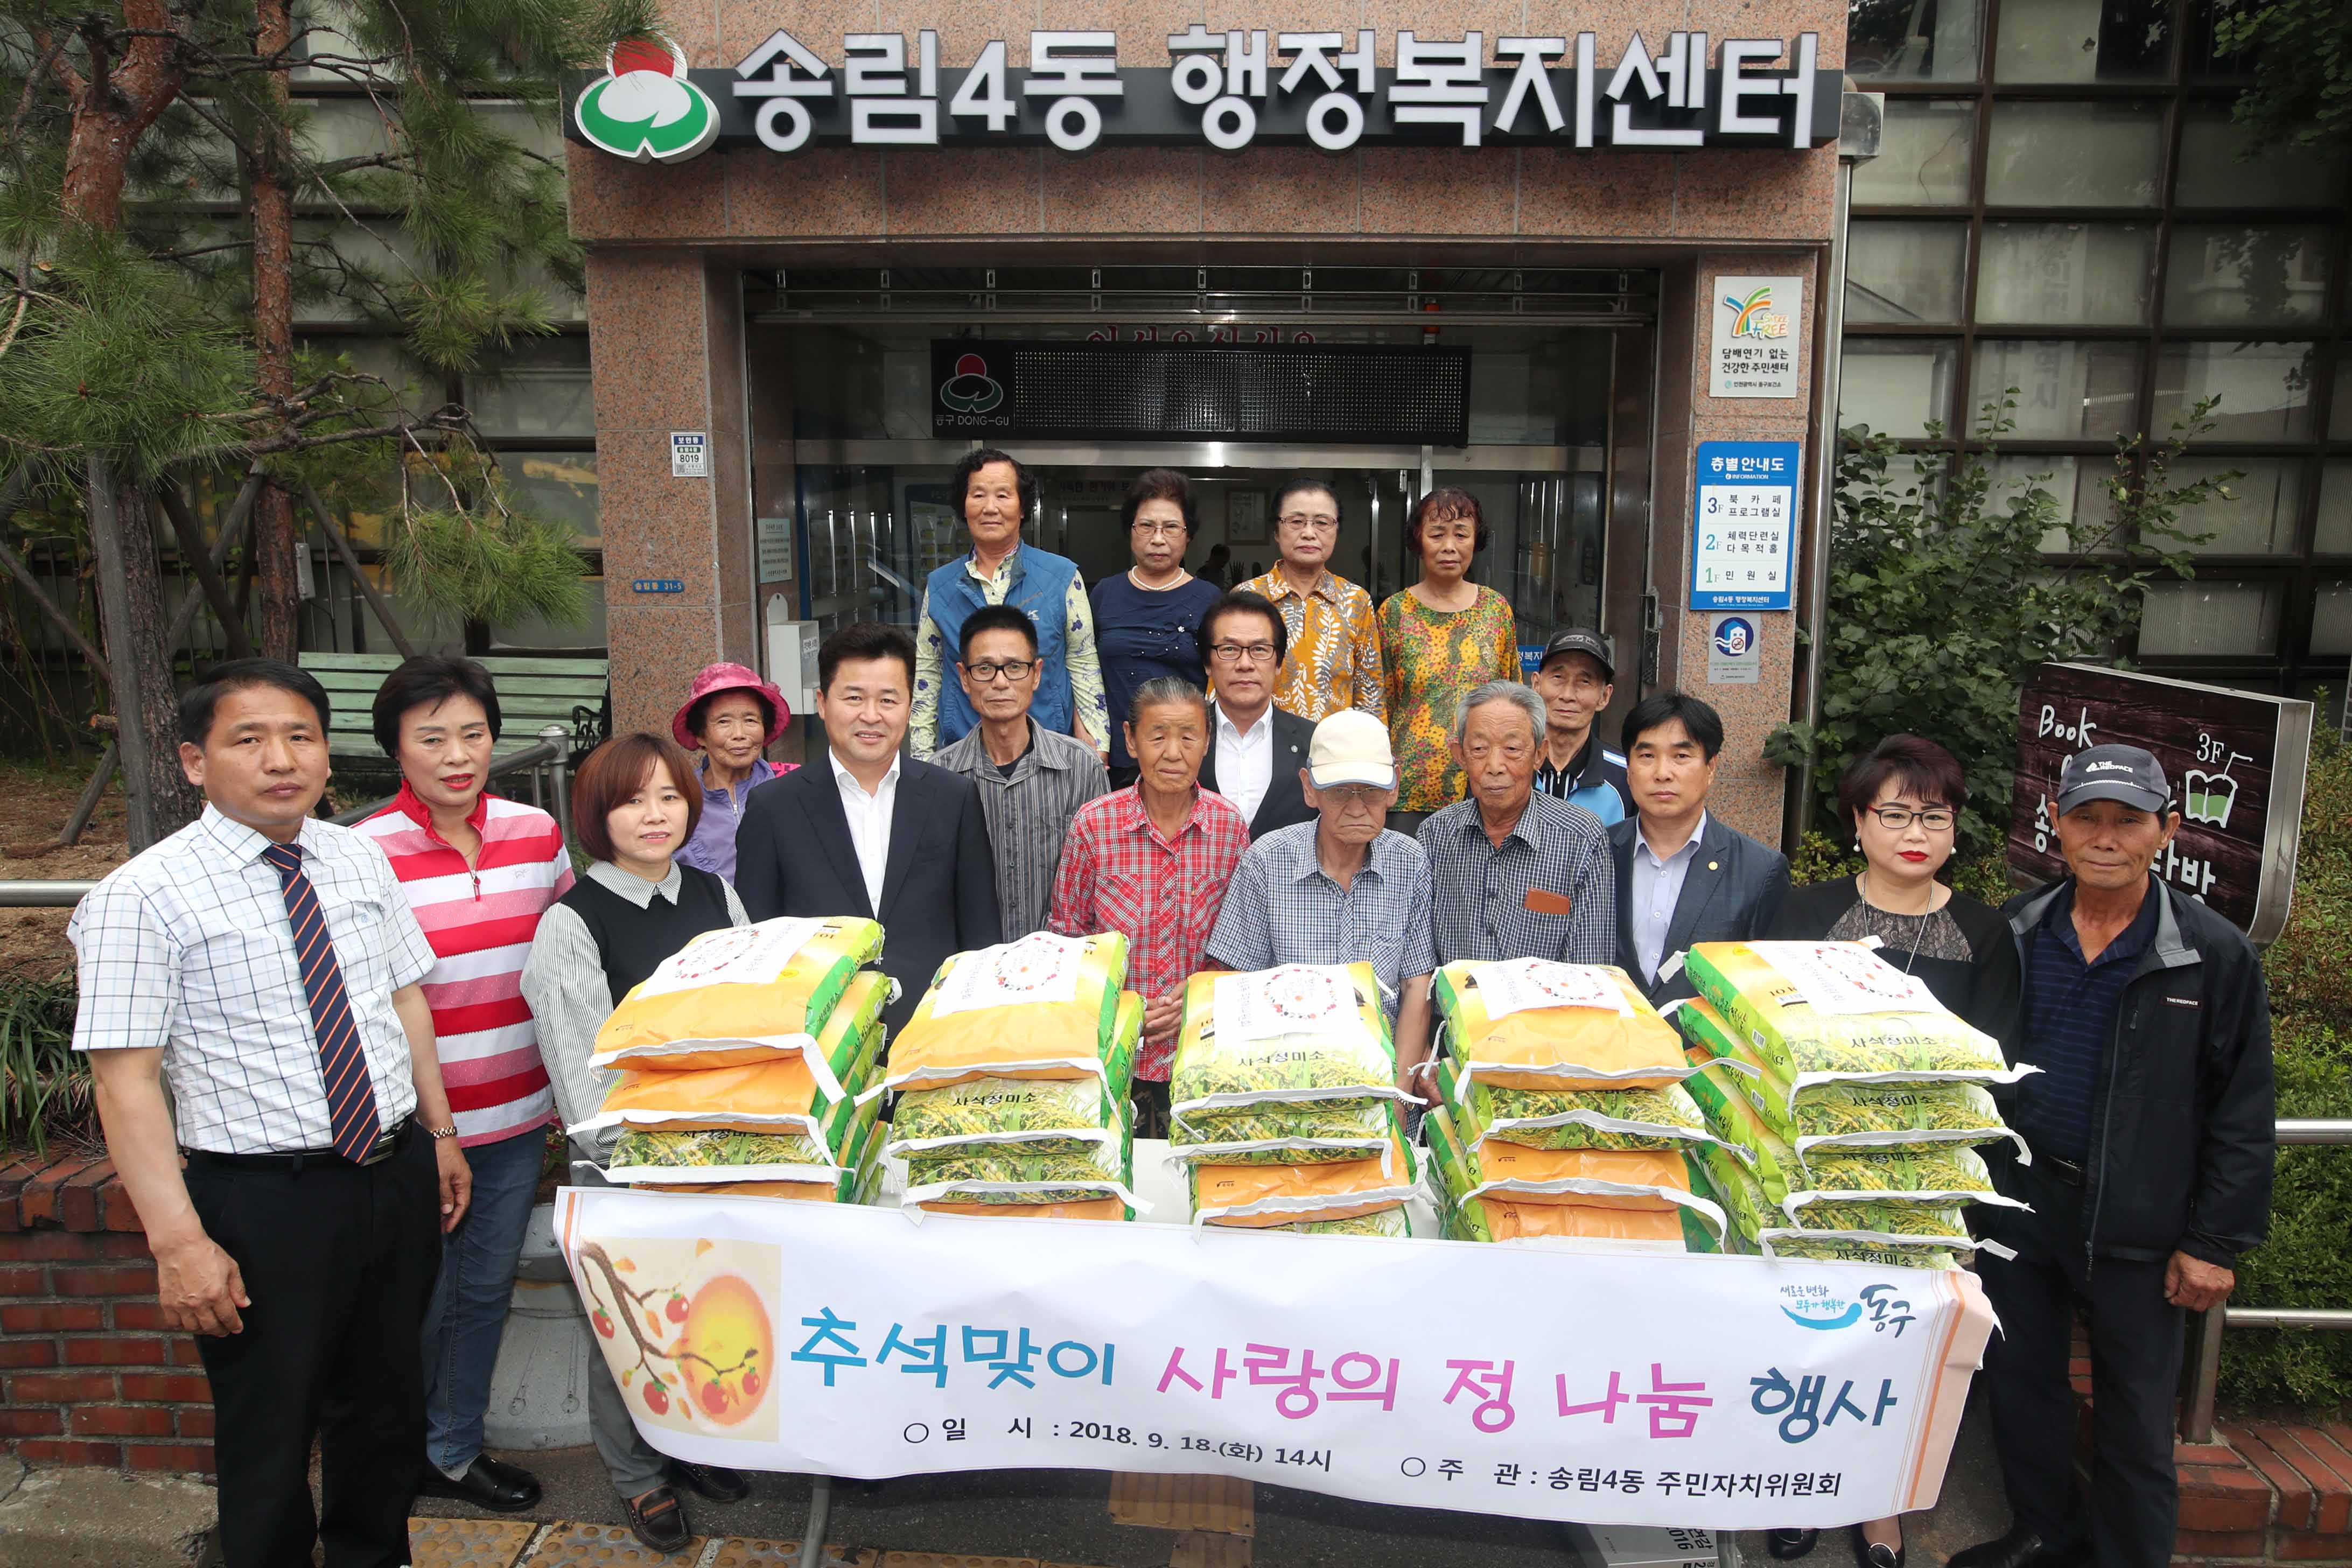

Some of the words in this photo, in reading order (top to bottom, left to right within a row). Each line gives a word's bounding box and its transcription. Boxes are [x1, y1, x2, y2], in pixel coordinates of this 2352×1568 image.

[733, 28, 1124, 152] 송림4동
[1167, 24, 1818, 150] 행정복지센터
[1753, 320, 1788, 337] FREE
[1723, 348, 1762, 359] 담배연기
[1769, 348, 1789, 359] 없는
[1722, 362, 1749, 373] 건강한
[1752, 362, 1789, 373] 주민센터
[935, 415, 955, 426] 동구
[957, 415, 1009, 425] DONG-GU
[680, 454, 699, 463] 8019
[1711, 457, 1738, 472] 층별
[1741, 457, 1784, 471] 안내도
[1707, 497, 1724, 514] 3F
[1728, 508, 1780, 517] 프로그램실
[1705, 534, 1721, 550] 2F
[1727, 531, 1779, 541] 체력단련실
[1705, 567, 1720, 583] 1F
[2038, 704, 2097, 748] Book
[2196, 733, 2224, 764] 3F
[2100, 765, 2133, 773] REDFACE
[1851, 1035, 1938, 1048] 사석정미소
[953, 1092, 1037, 1107] 사석정미소
[1852, 1093, 1936, 1107] 사석정미소
[1836, 1250, 1914, 1267] 사석정미소
[1796, 1299, 1819, 1313] 모두가
[1821, 1298, 1845, 1313] 행복한
[1860, 1284, 1916, 1338] 동구
[791, 1306, 1115, 1389] 추석맞이
[1157, 1342, 1400, 1419] 사랑의
[1443, 1359, 1515, 1433] 정
[1556, 1362, 1713, 1439] 나눔
[1749, 1367, 1898, 1444] 행사
[1069, 1421, 1138, 1446] 2018.
[1147, 1432, 1169, 1450] 9.
[1180, 1437, 1263, 1464] 18.(화)
[1275, 1448, 1332, 1472] 14시
[1548, 1466, 1646, 1494] 송림4동
[1656, 1471, 1843, 1498] 주민자치위원회
[1667, 1527, 1694, 1549] 016
